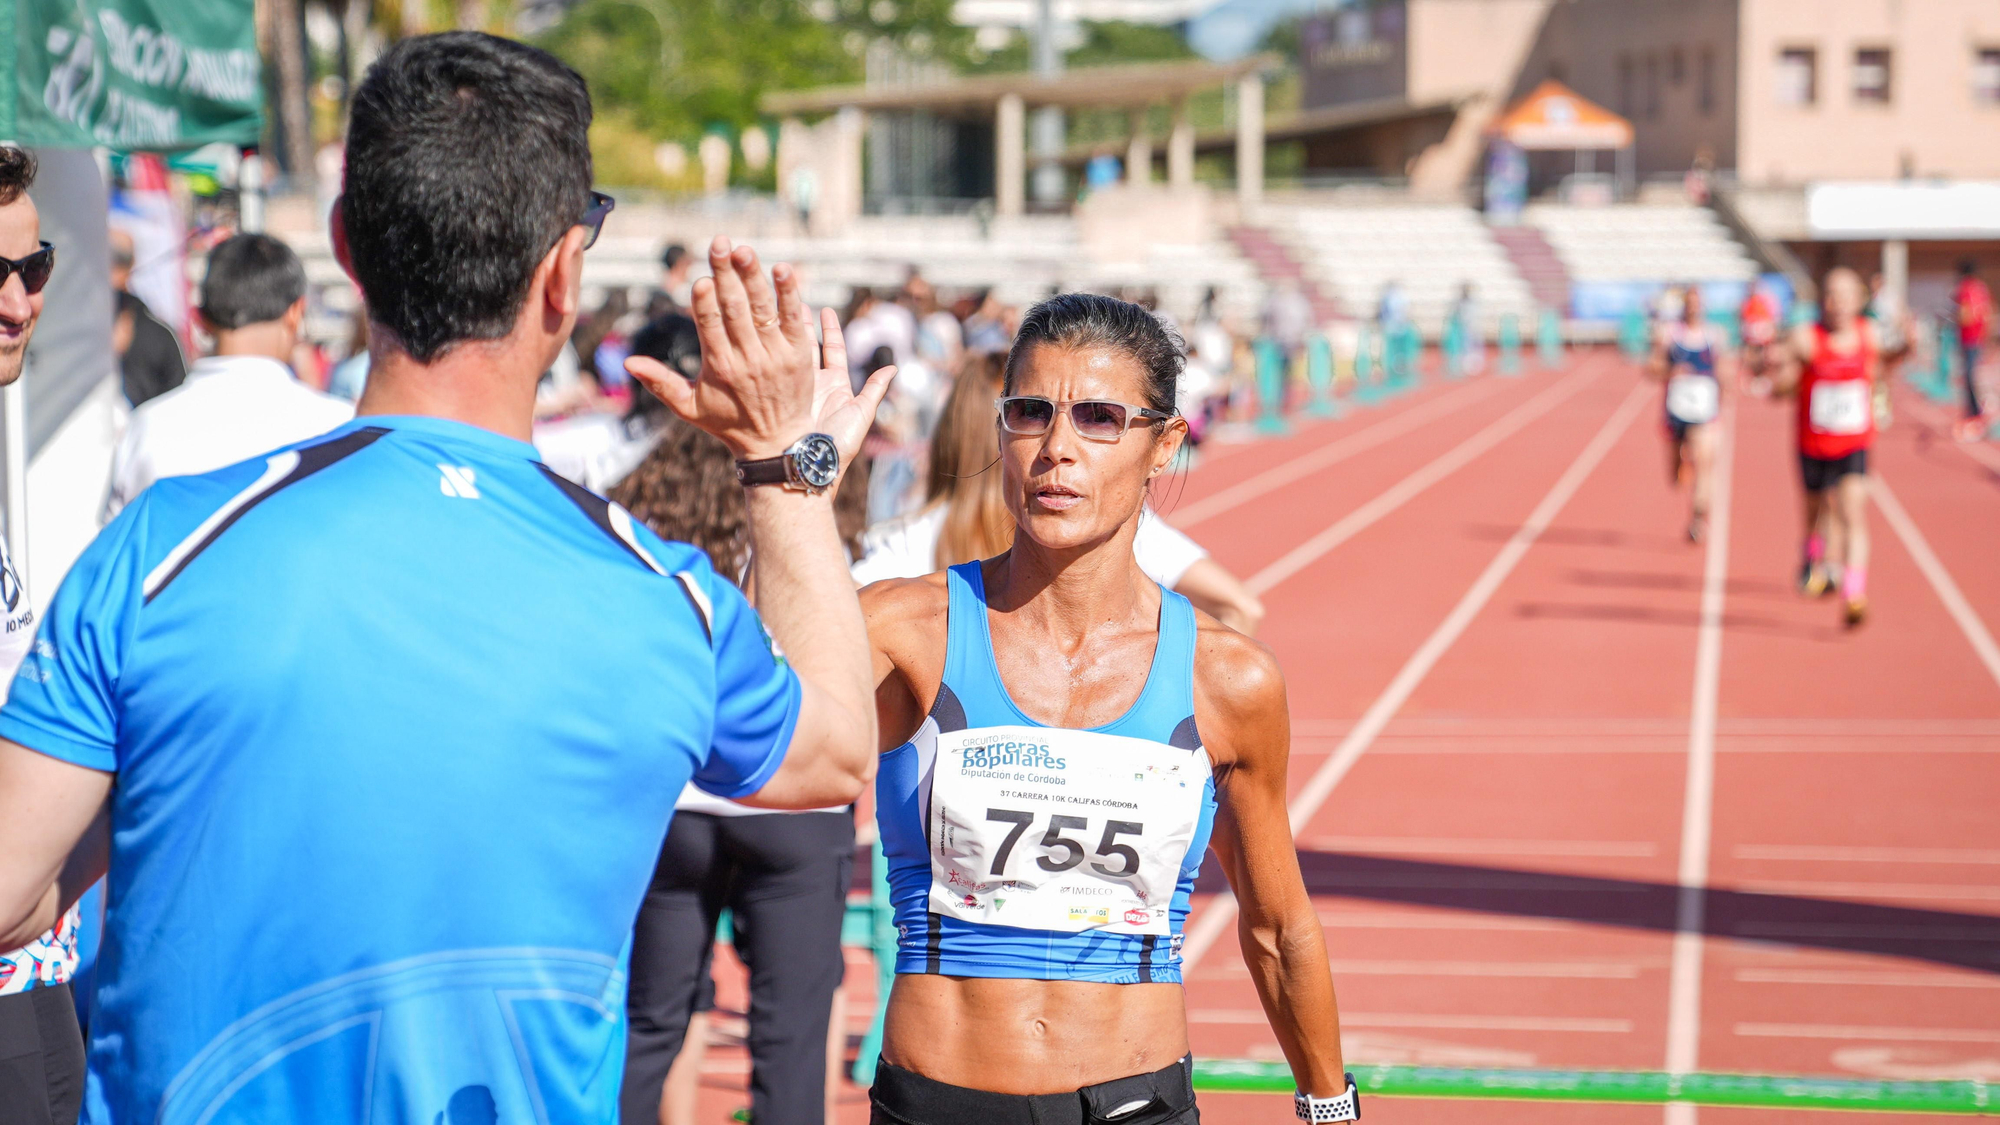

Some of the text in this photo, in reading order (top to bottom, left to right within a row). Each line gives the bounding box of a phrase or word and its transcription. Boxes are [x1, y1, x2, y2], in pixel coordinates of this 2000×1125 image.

[962, 735, 999, 747] CIRCUITO
[963, 742, 1050, 759] carreras
[962, 749, 1067, 770] populares
[961, 768, 1011, 779] Diputación
[1013, 772, 1025, 781] de
[1011, 791, 1049, 801] CARRERA
[1051, 795, 1066, 803] 10K
[1067, 796, 1101, 806] CALIFAS
[1102, 799, 1138, 810] CÓRDOBA
[986, 808, 1144, 878] 755
[1072, 886, 1113, 896] IMDECO
